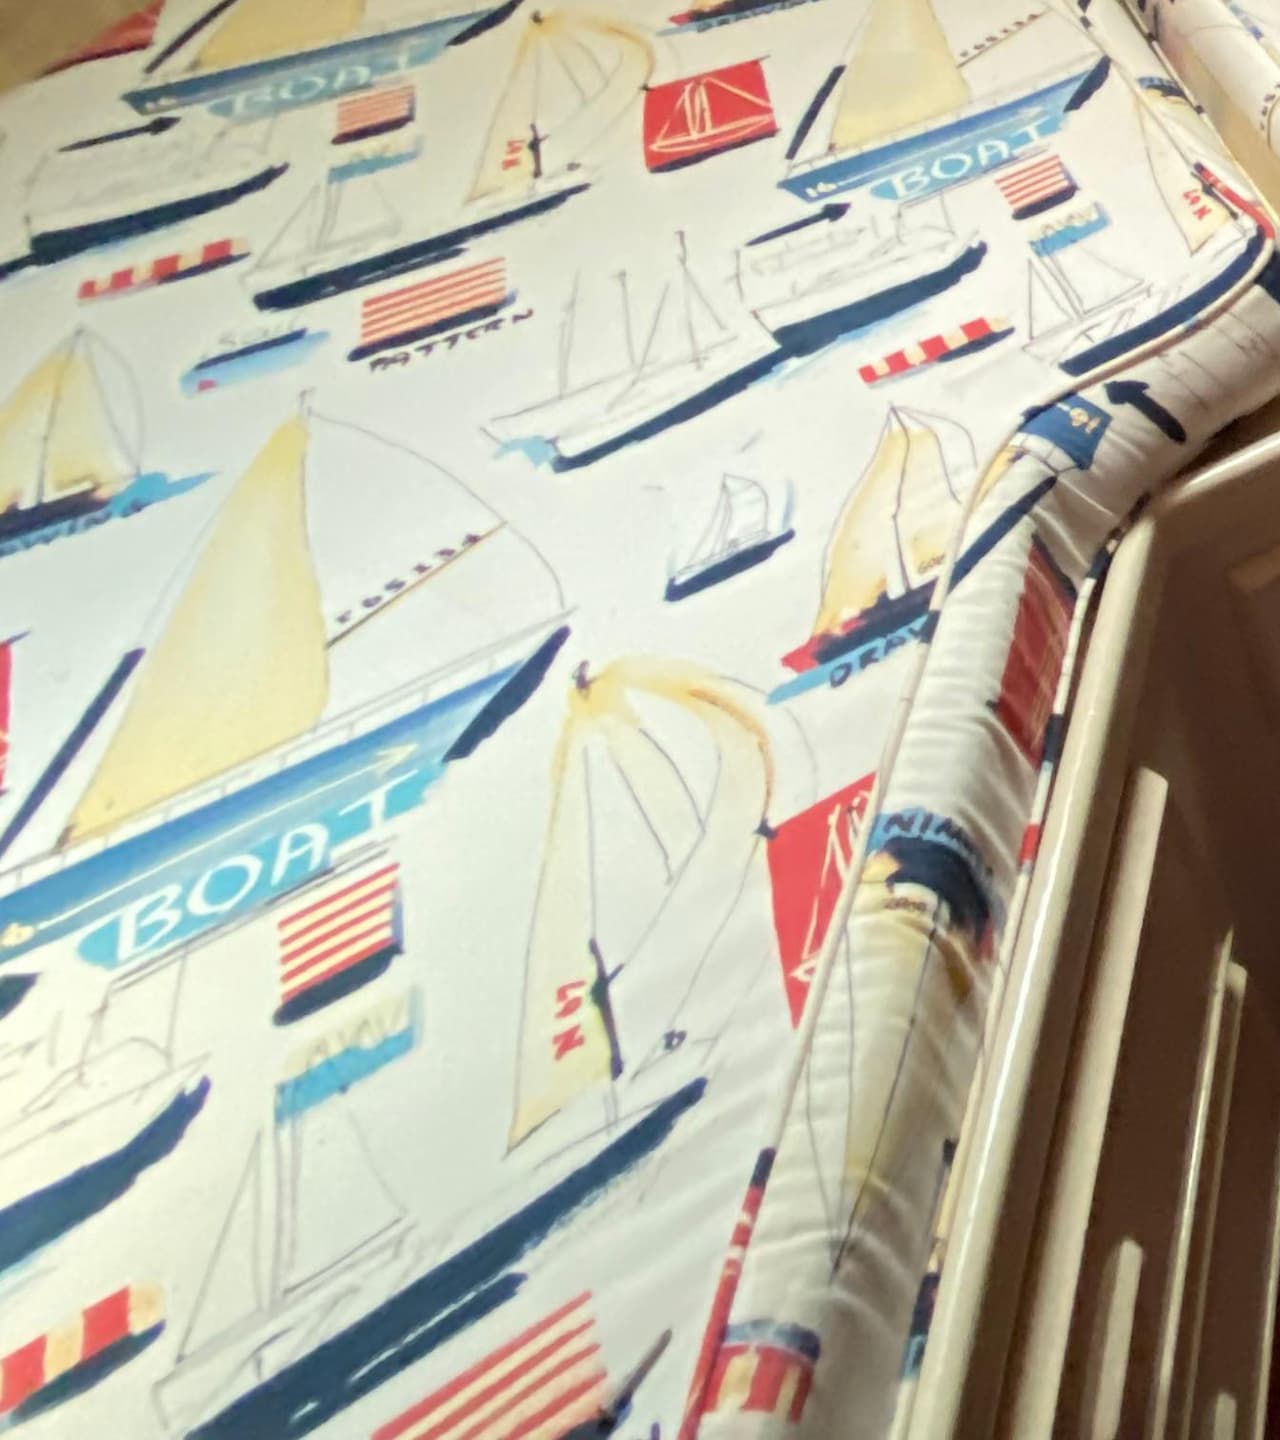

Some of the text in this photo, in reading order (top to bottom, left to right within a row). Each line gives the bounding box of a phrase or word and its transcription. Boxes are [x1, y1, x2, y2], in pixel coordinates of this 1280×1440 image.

[888, 116, 1049, 197] BOAT
[370, 308, 535, 373] PATTERN
[116, 768, 420, 962] BOAT
